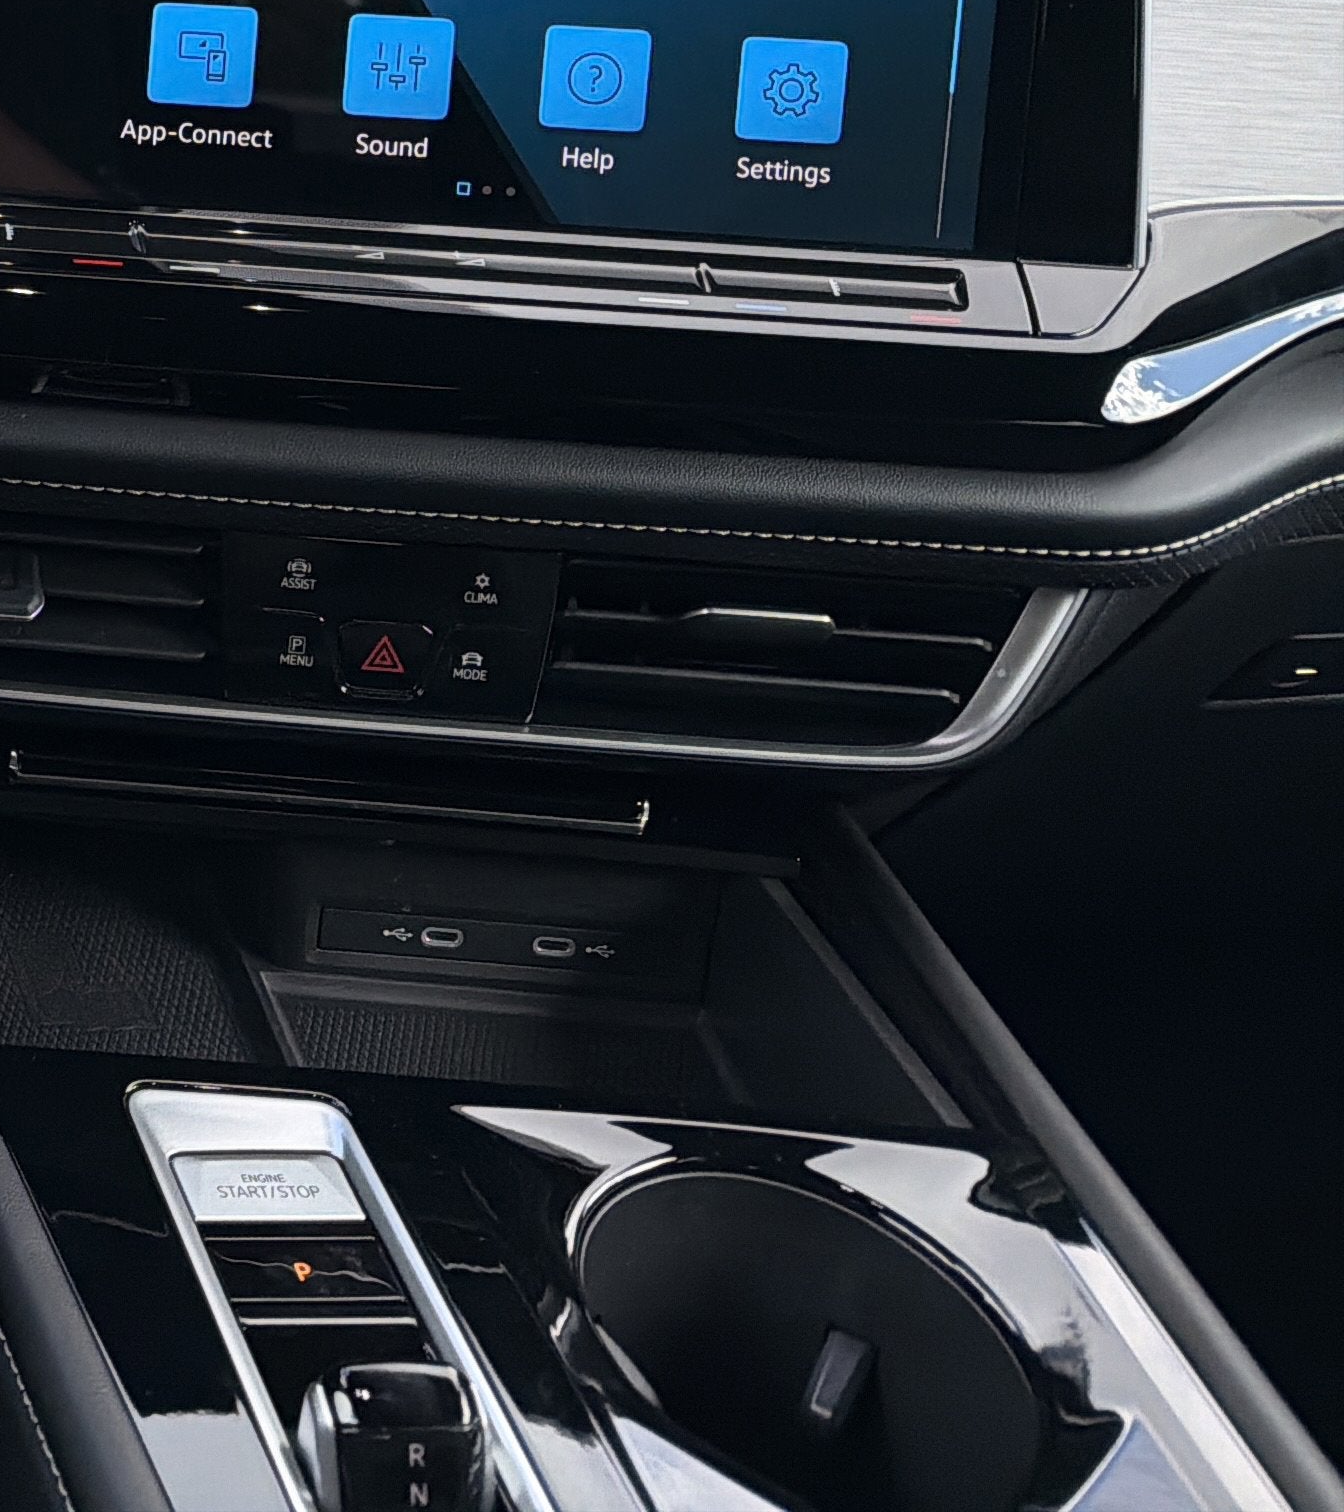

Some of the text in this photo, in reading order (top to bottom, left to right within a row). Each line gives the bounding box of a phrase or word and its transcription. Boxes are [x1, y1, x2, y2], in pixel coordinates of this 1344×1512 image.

[121, 119, 272, 148] App-Connect
[356, 134, 428, 157] Sound
[563, 147, 613, 174] Help
[736, 157, 830, 187] Settings
[281, 576, 316, 590] ASSIST
[464, 591, 497, 604] CLIMA
[280, 654, 313, 667] MENU
[453, 668, 487, 681] MODE
[241, 1174, 286, 1183] ENGINE
[217, 1185, 319, 1198] START/STOP
[293, 1262, 311, 1281] P
[409, 1443, 424, 1466] R
[410, 1483, 427, 1505] N
